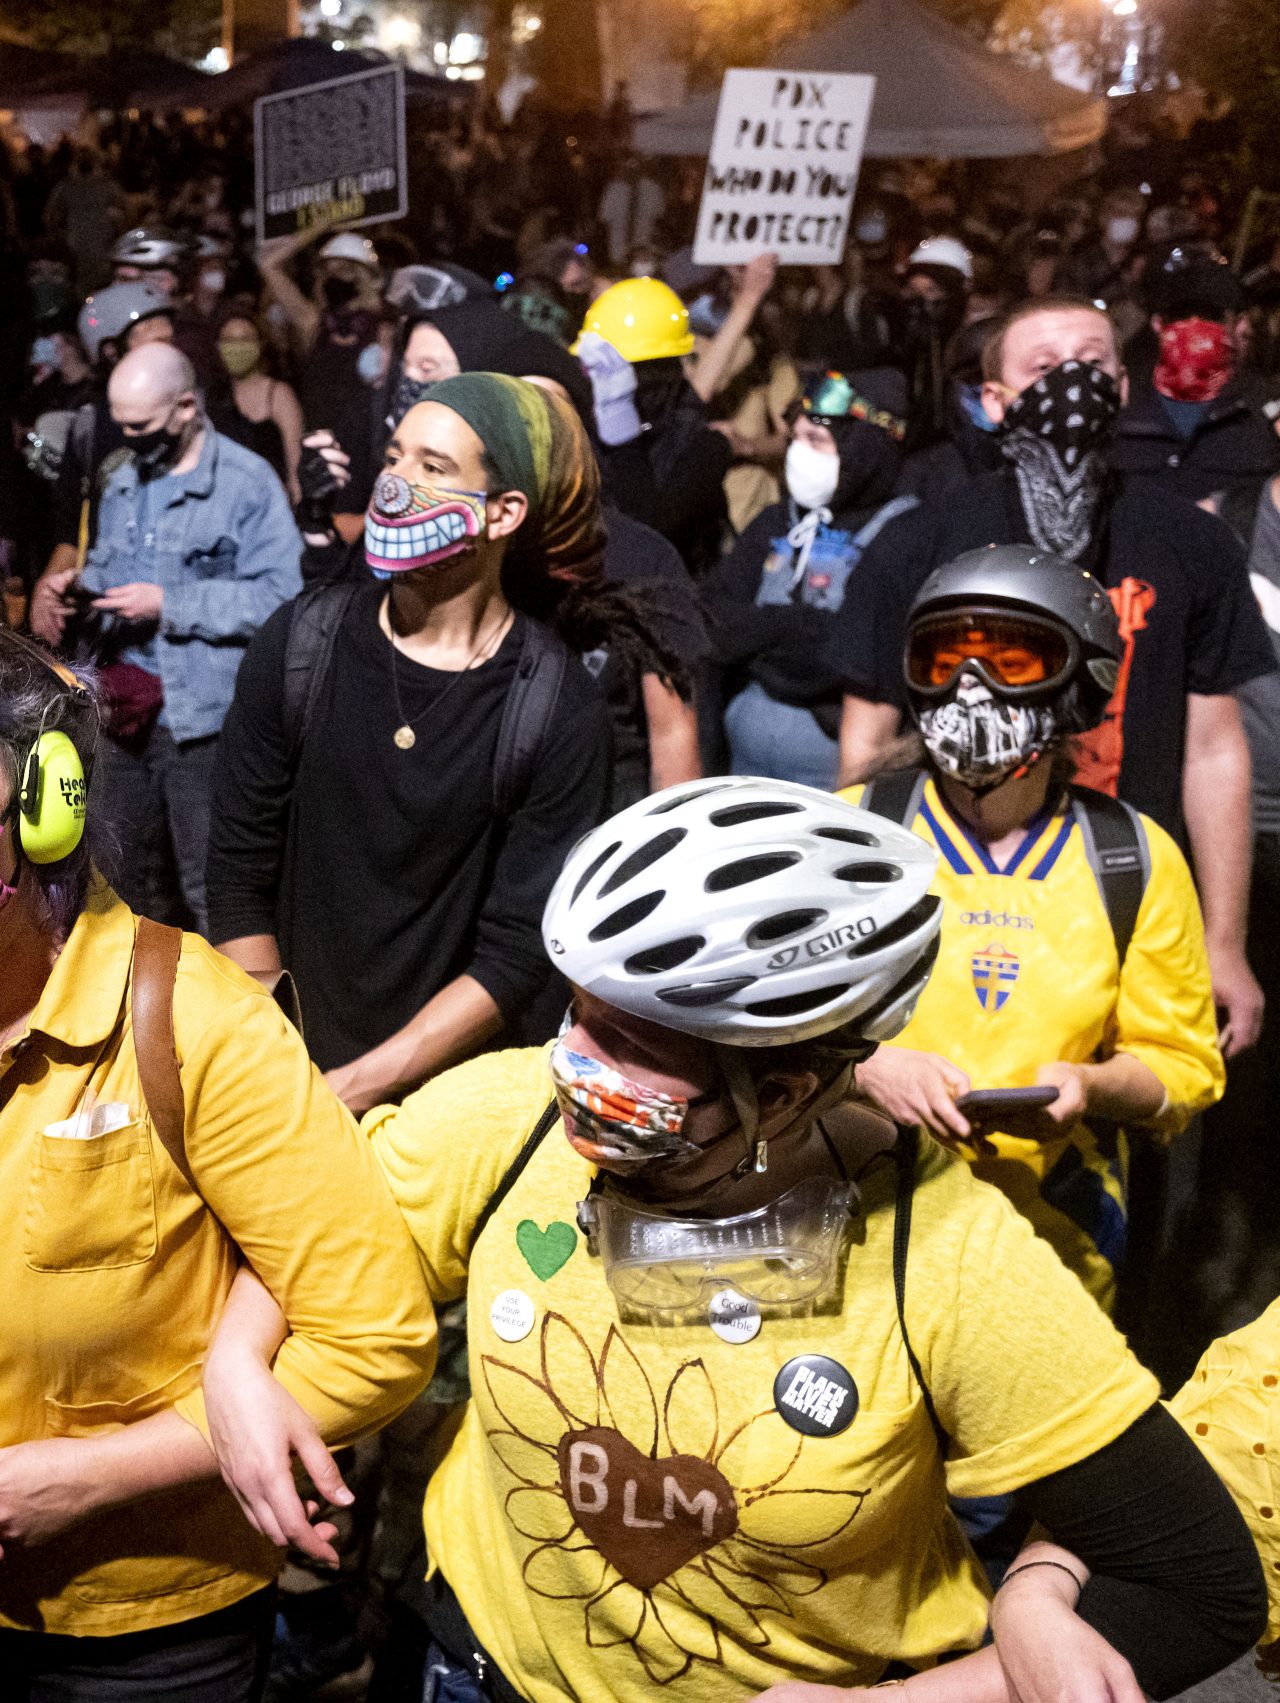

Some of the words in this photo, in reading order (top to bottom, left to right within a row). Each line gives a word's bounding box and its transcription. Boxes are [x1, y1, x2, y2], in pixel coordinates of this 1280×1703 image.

[771, 78, 832, 108] PDX
[735, 118, 852, 150] POLICE
[707, 163, 762, 195] WHO
[769, 168, 797, 194] DO
[805, 164, 856, 198] YOU
[708, 211, 842, 249] PROTECT?
[960, 909, 1034, 930] adidas
[805, 916, 878, 958] GIRO
[501, 1305, 521, 1315] YOUR
[505, 1296, 519, 1305] USE
[721, 1298, 749, 1313] Good
[491, 1313, 526, 1328] PRIVILEGE
[711, 1312, 753, 1332] Trouble
[795, 1365, 849, 1401] BLACK
[780, 1390, 838, 1428] MATTER
[569, 1440, 718, 1538] BLM
